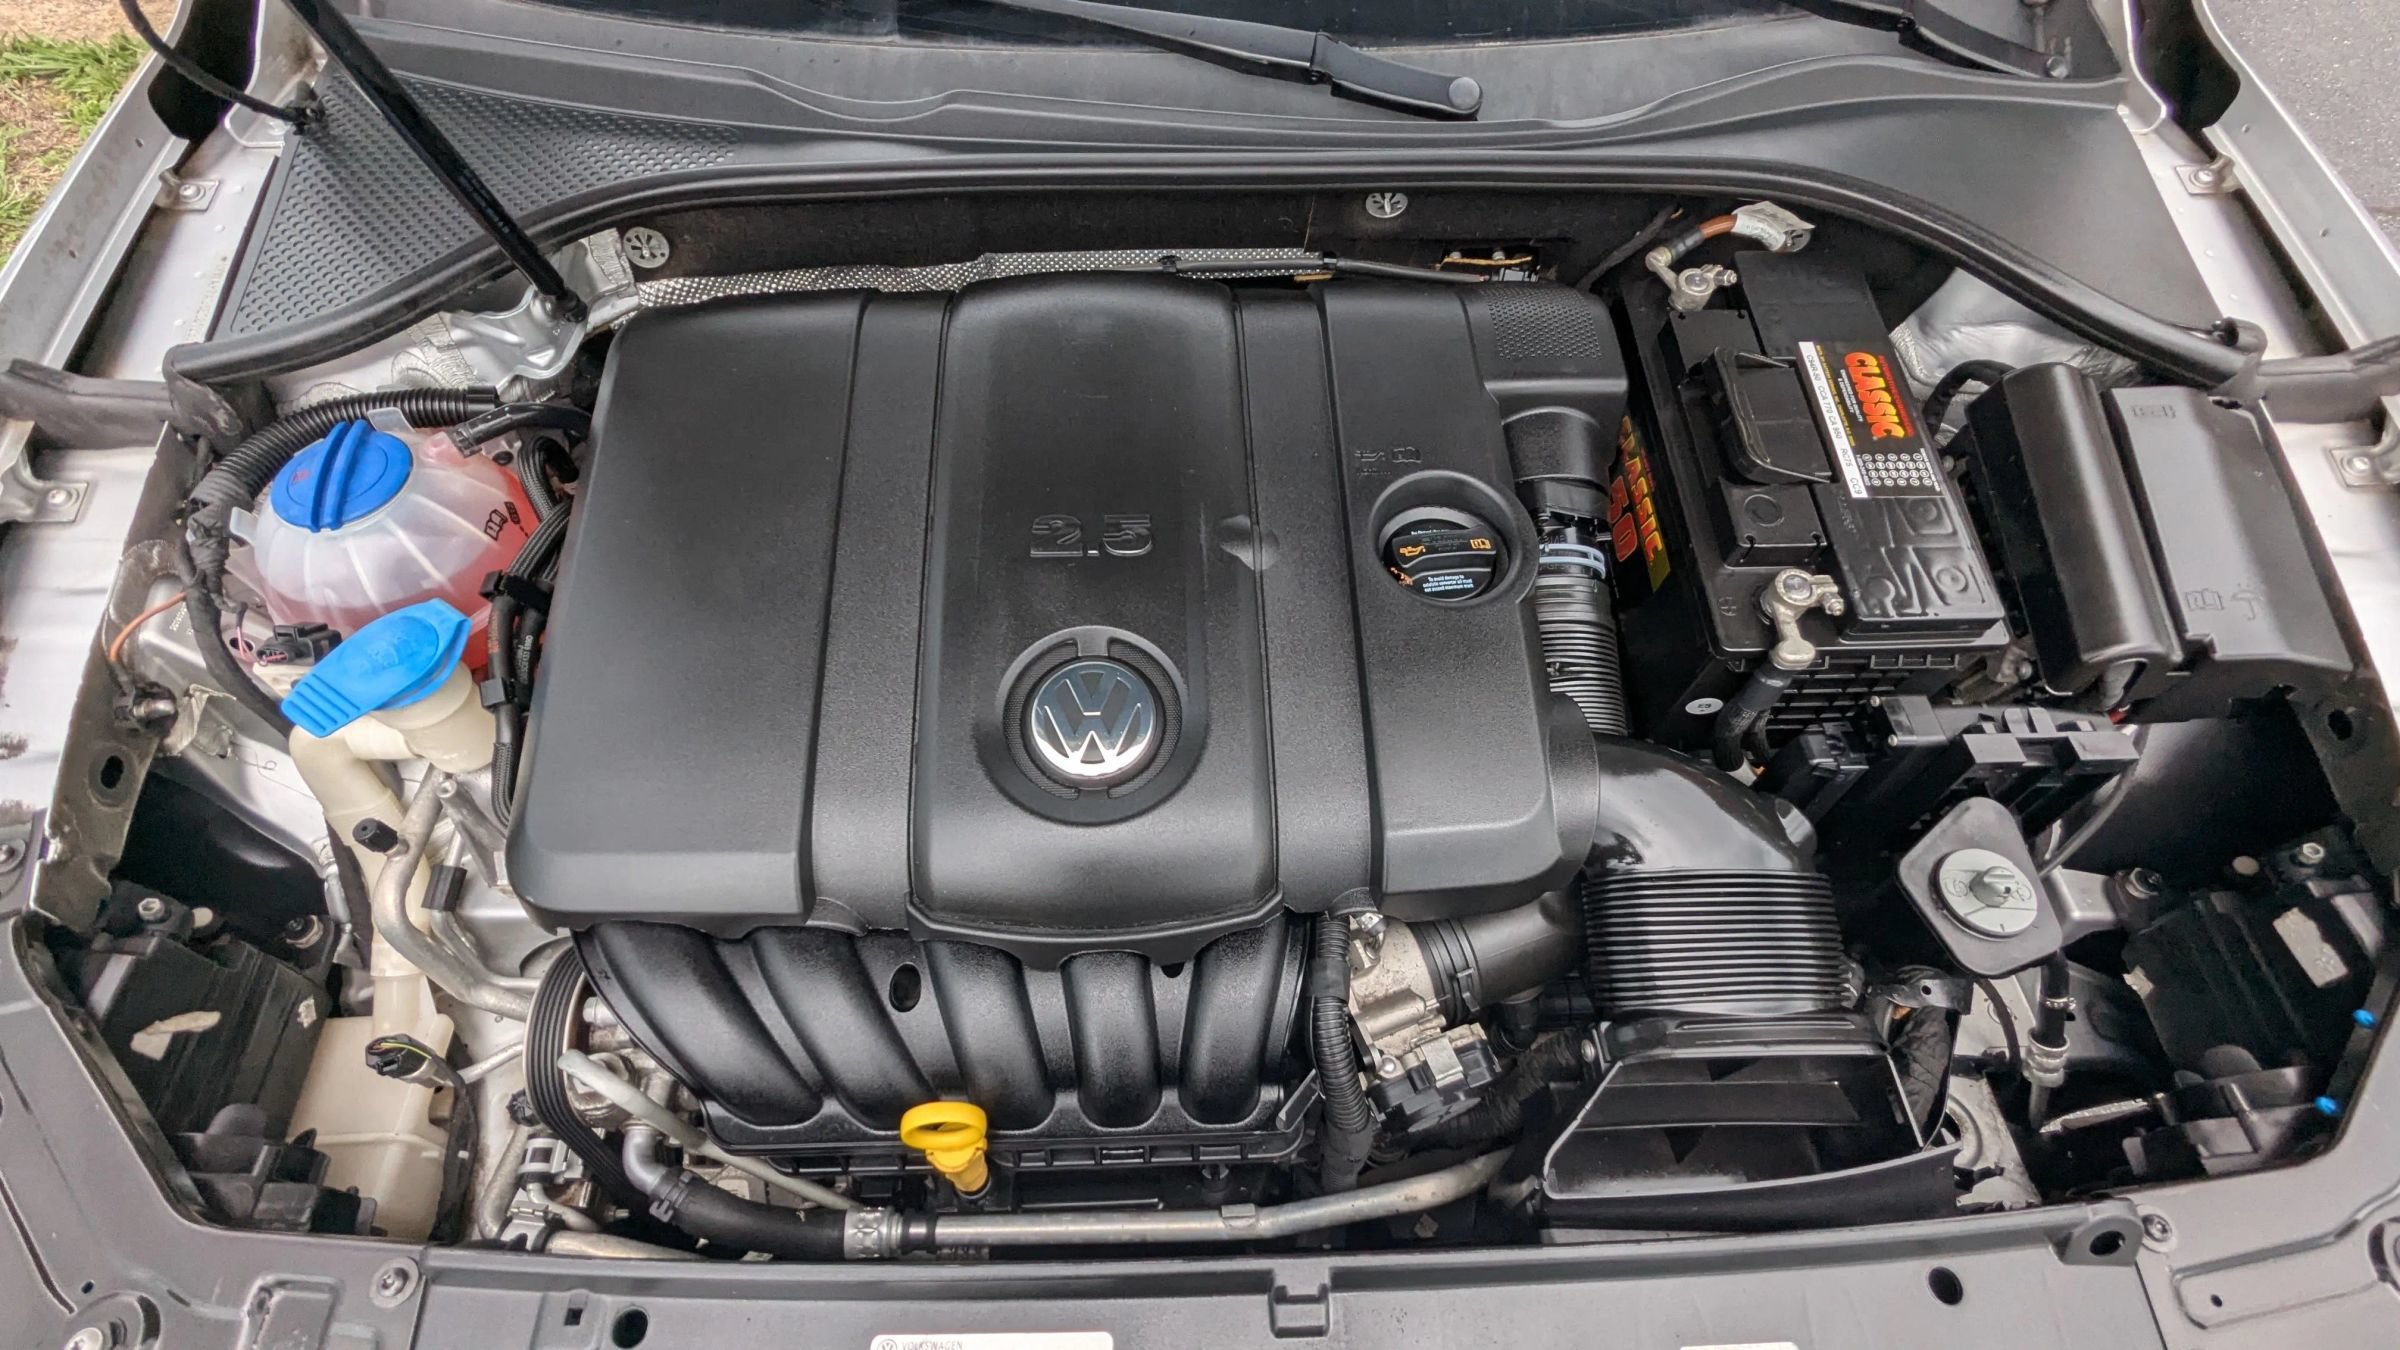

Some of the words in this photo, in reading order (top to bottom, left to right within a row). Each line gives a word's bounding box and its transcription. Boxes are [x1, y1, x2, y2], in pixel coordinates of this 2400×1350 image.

[1816, 385, 1829, 400] CCA
[1828, 415, 1838, 425] CA
[1840, 448, 1853, 466] RC75
[1845, 352, 1905, 437] CLASSIC
[1607, 475, 1638, 562] 50
[1616, 415, 1663, 562] CLASSIC
[1030, 514, 1152, 557] 2.5
